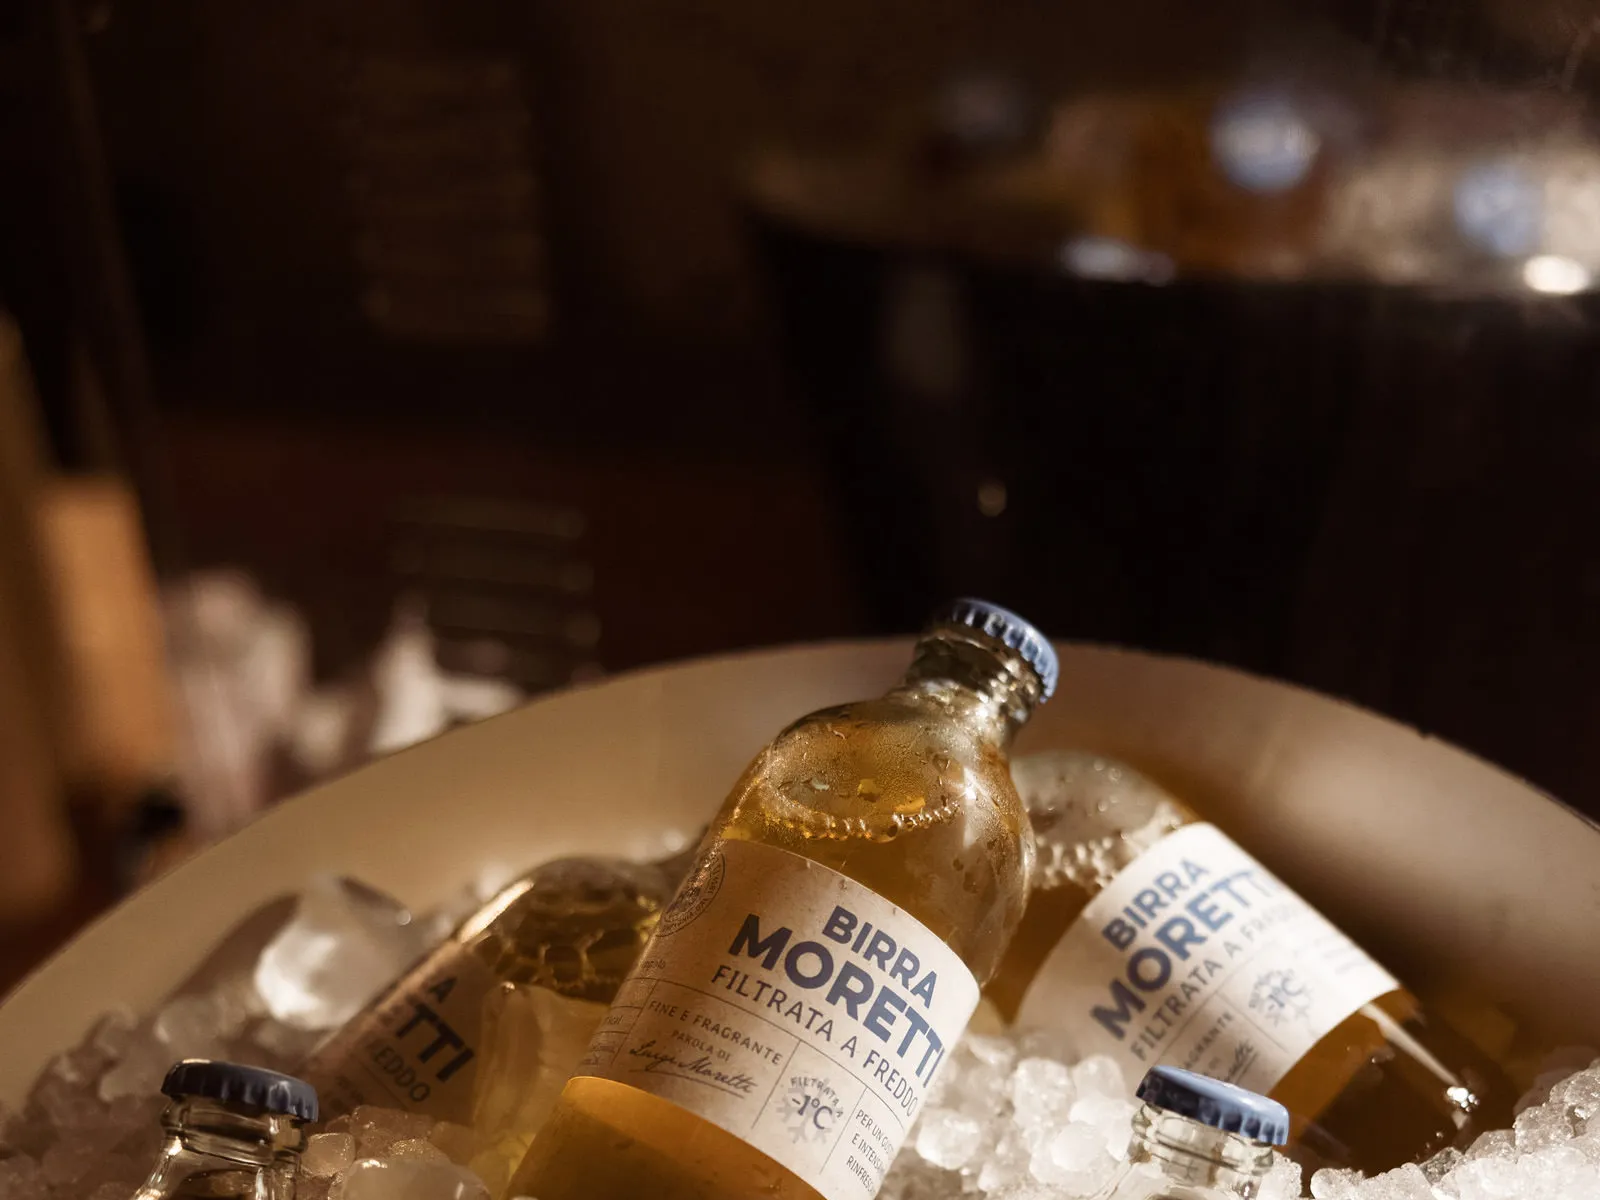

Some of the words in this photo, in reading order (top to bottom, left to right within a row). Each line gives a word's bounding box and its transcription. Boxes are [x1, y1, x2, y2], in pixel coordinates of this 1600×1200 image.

[1102, 857, 1210, 953] BIRRA
[822, 905, 937, 1009] BIRRA
[649, 1001, 677, 1018] FINE
[680, 1009, 690, 1022] E
[693, 1015, 783, 1065] FRAGRANTE
[711, 965, 834, 1042] FILTRATA
[841, 1035, 858, 1059] A
[863, 1050, 919, 1117] FREDDO
[728, 914, 945, 1088] MORETTI
[1130, 958, 1223, 1062] FILTRATA
[1223, 940, 1243, 959] A
[671, 1029, 714, 1055] PAROLA
[717, 1050, 732, 1062] DI
[790, 1075, 840, 1107] FILTRATA
[855, 1109, 874, 1130] PER
[872, 1124, 883, 1142] UN
[851, 1133, 860, 1145] E
